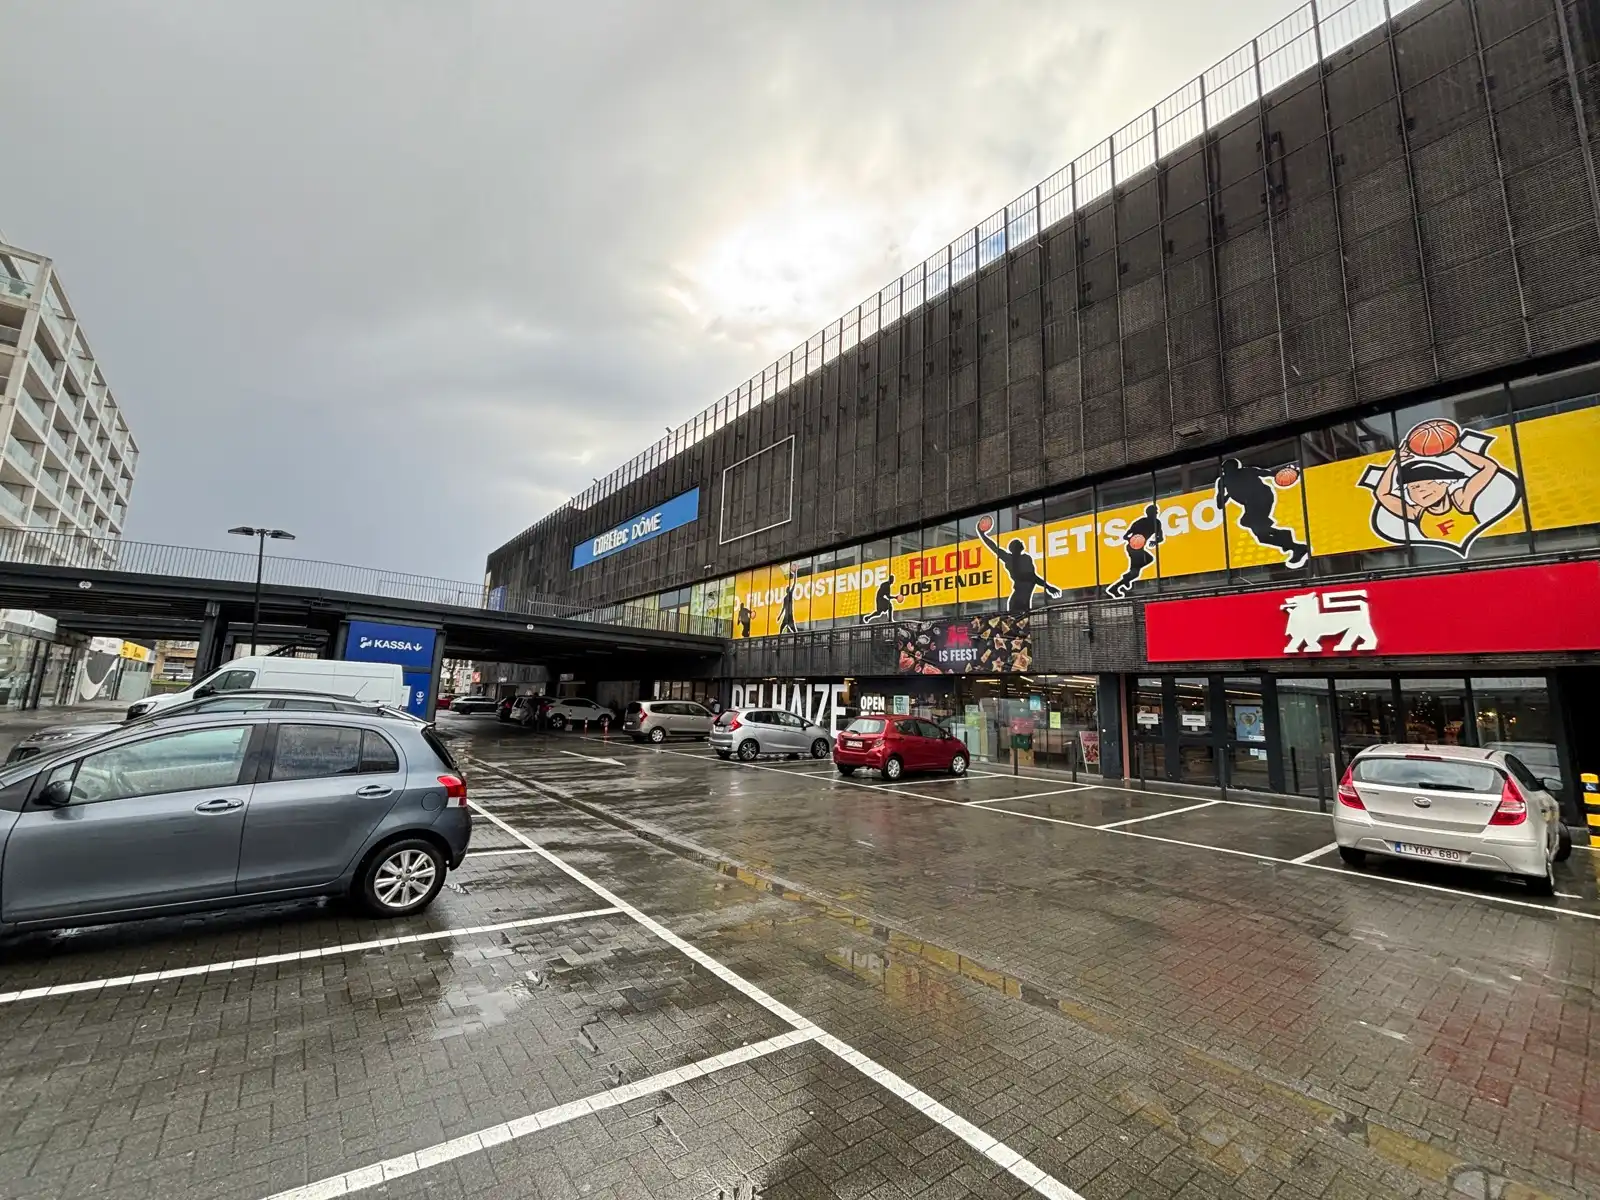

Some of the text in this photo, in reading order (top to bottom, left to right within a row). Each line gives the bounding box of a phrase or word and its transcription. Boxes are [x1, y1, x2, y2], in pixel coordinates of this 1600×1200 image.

[631, 512, 662, 540] DÔME
[1028, 499, 1224, 560] LET'S GO
[1436, 519, 1455, 536] F
[909, 547, 982, 580] FILOU
[793, 565, 888, 601] OOSTENDE
[900, 570, 993, 597] OOSTENDE
[374, 639, 412, 651] KASSA
[938, 648, 978, 662] IS FEEST
[860, 696, 885, 710] OPEN
